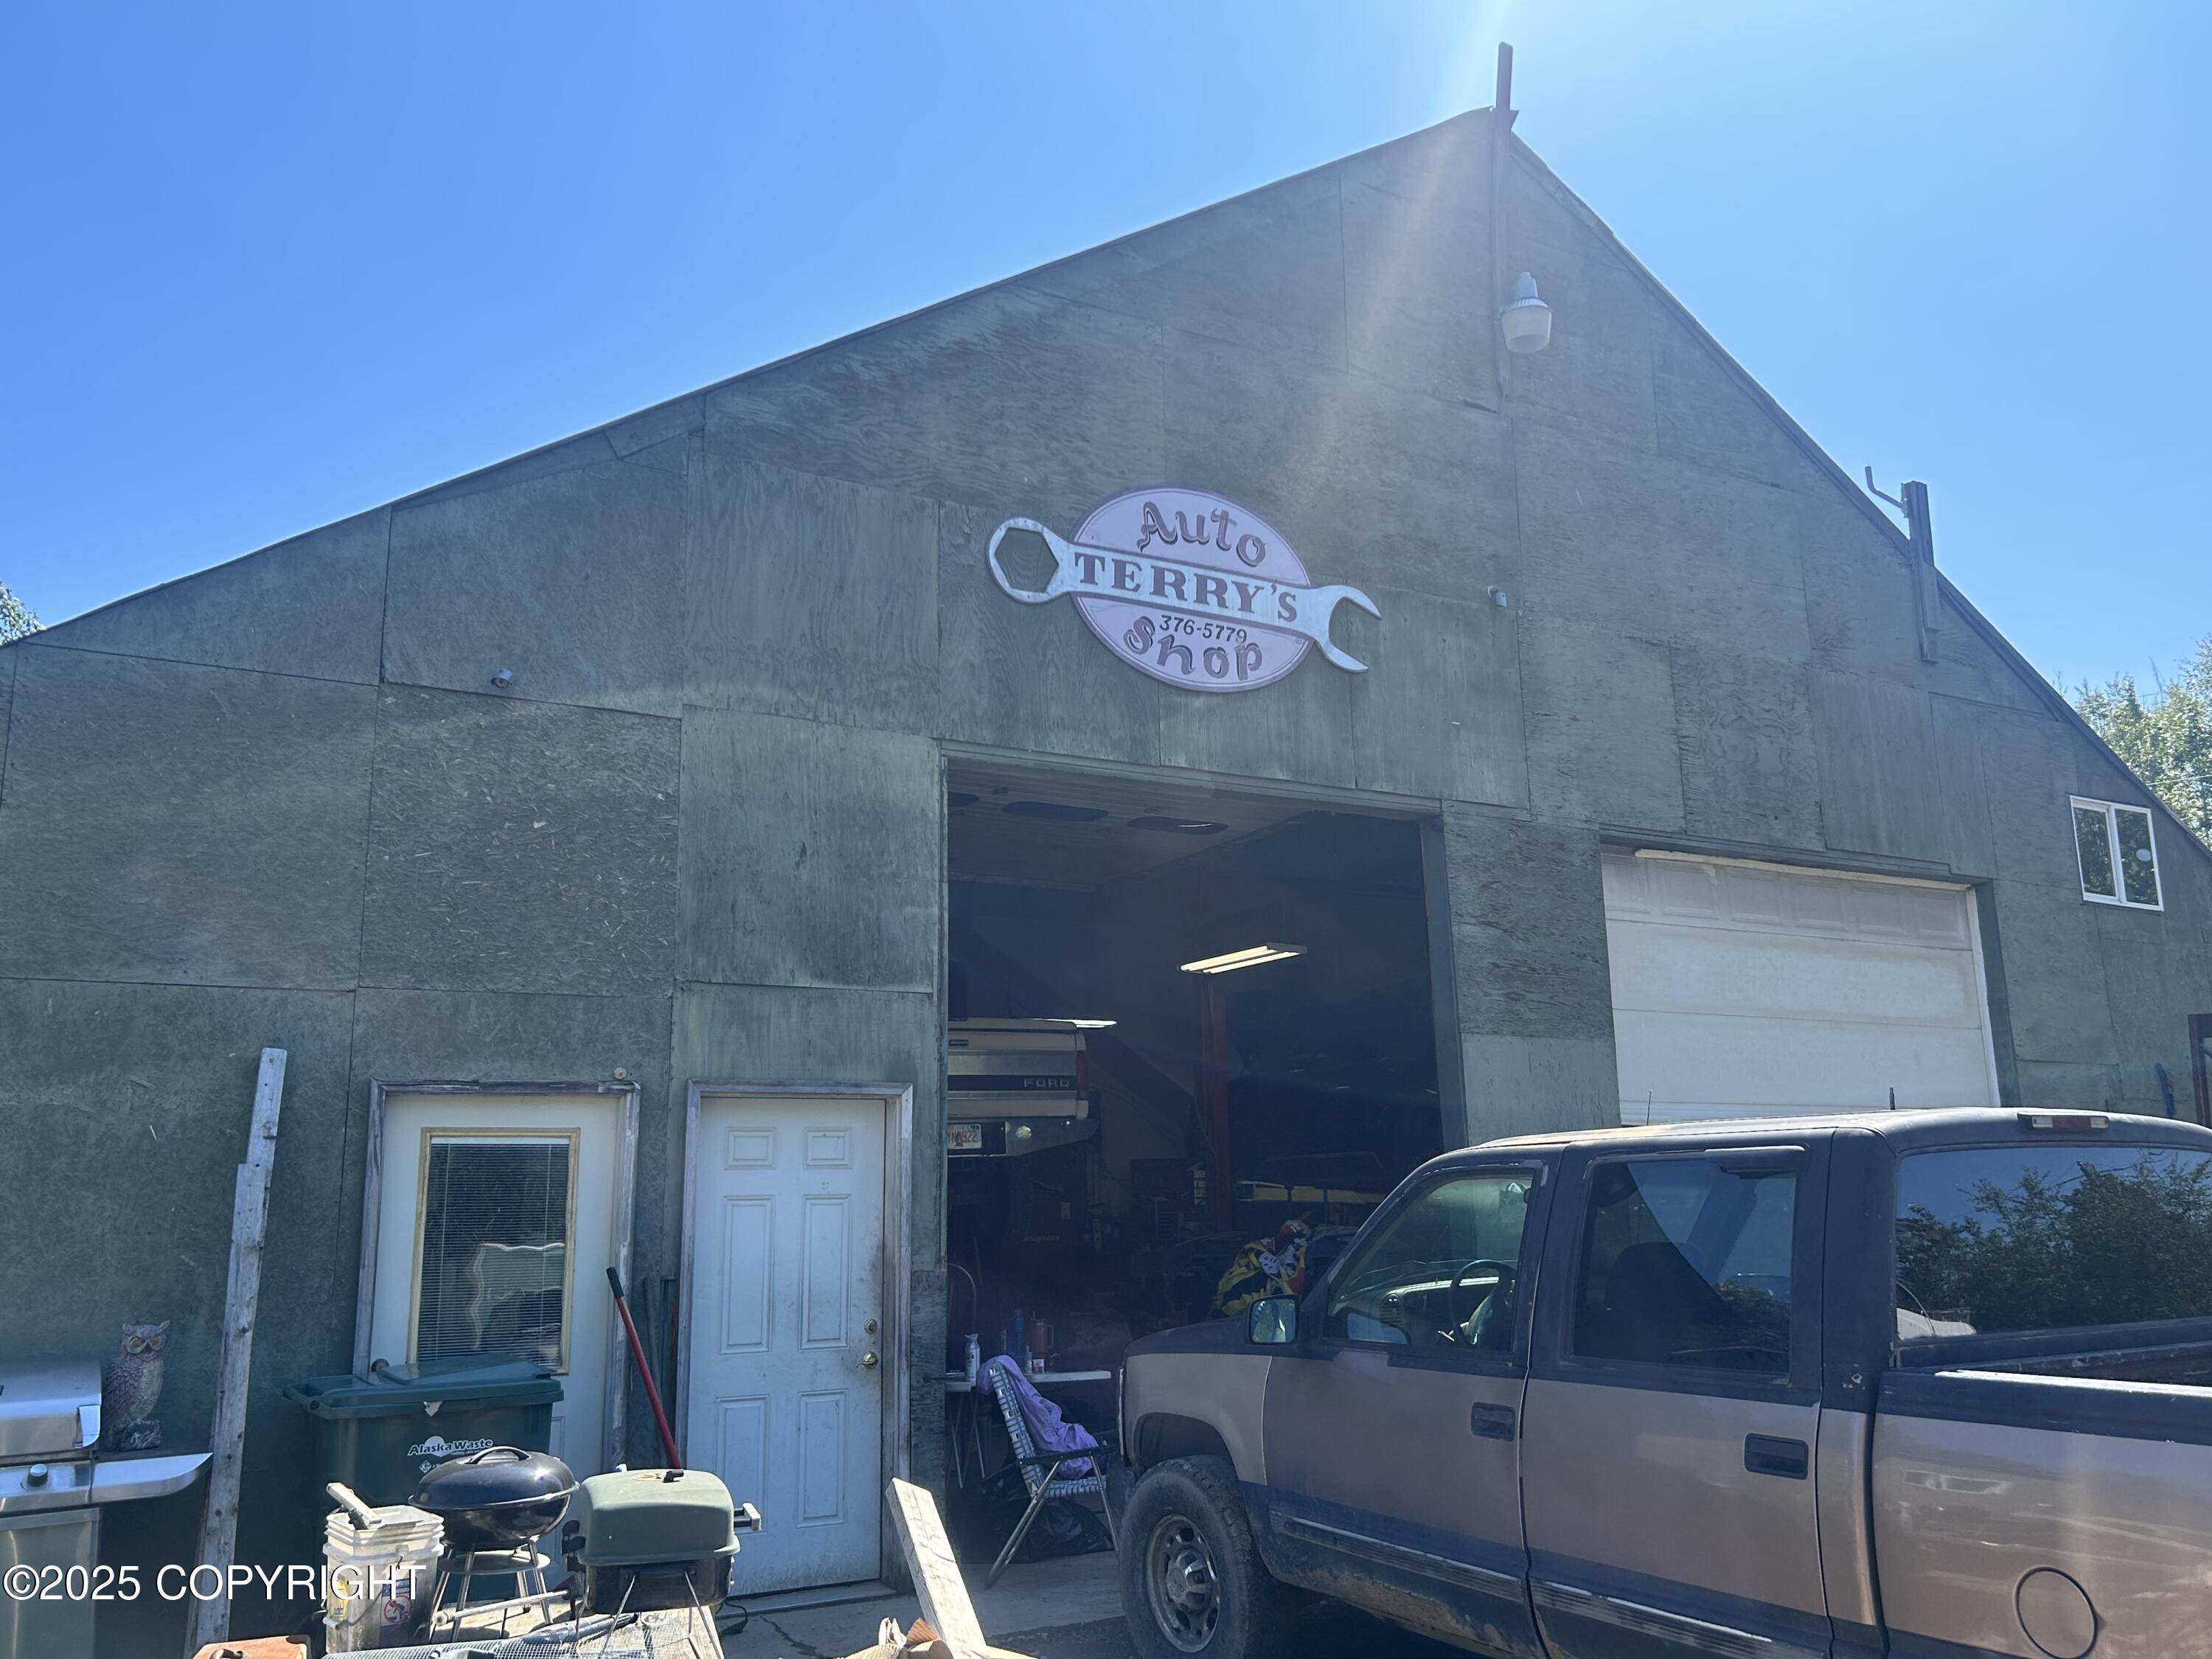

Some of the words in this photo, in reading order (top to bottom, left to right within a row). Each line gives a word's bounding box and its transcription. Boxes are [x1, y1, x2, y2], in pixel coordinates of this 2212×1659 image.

[1137, 501, 1266, 567] Auto
[1074, 552, 1298, 622] TERRY'S
[1123, 616, 1263, 681] Shop
[1159, 615, 1248, 644] 376-5779
[1023, 1078, 1069, 1088] FORD
[408, 1443, 452, 1455] Alaska
[453, 1439, 493, 1450] Waste
